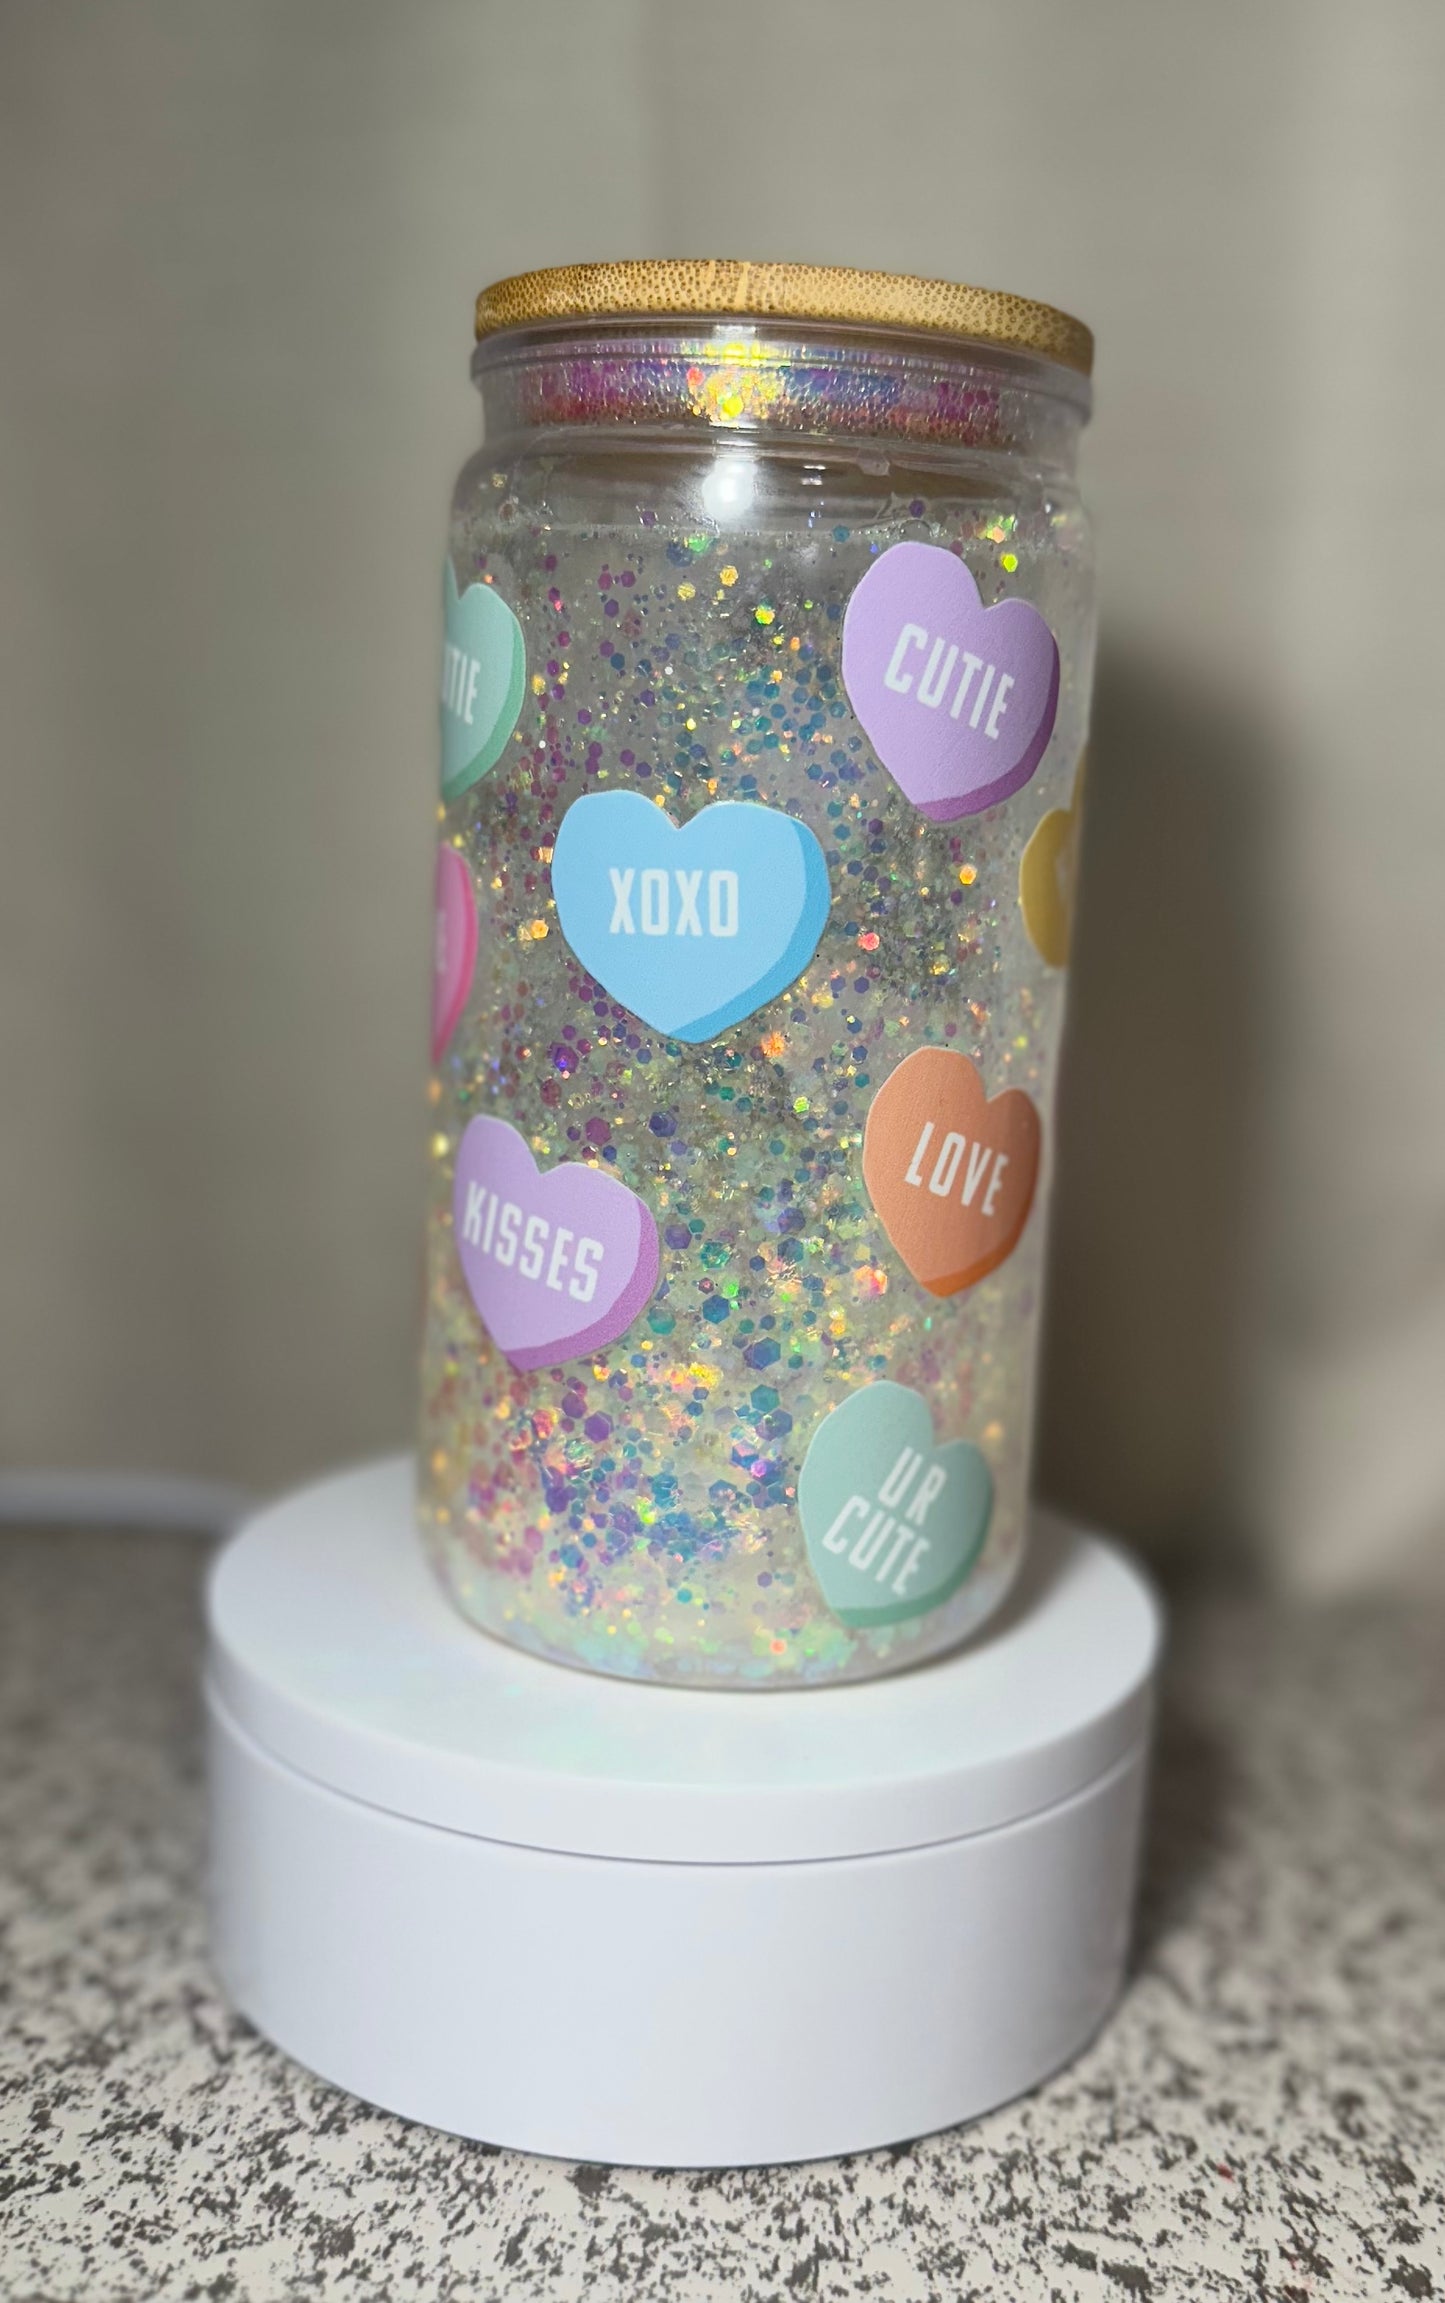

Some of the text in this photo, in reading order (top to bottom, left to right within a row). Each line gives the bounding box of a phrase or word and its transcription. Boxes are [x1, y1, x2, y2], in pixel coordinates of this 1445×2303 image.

[884, 623, 1016, 740] CUTIE
[608, 867, 739, 937] XOXO
[904, 1121, 1009, 1216] LOVE
[461, 1180, 604, 1302] KISSES
[822, 1495, 931, 1595] CUTE
